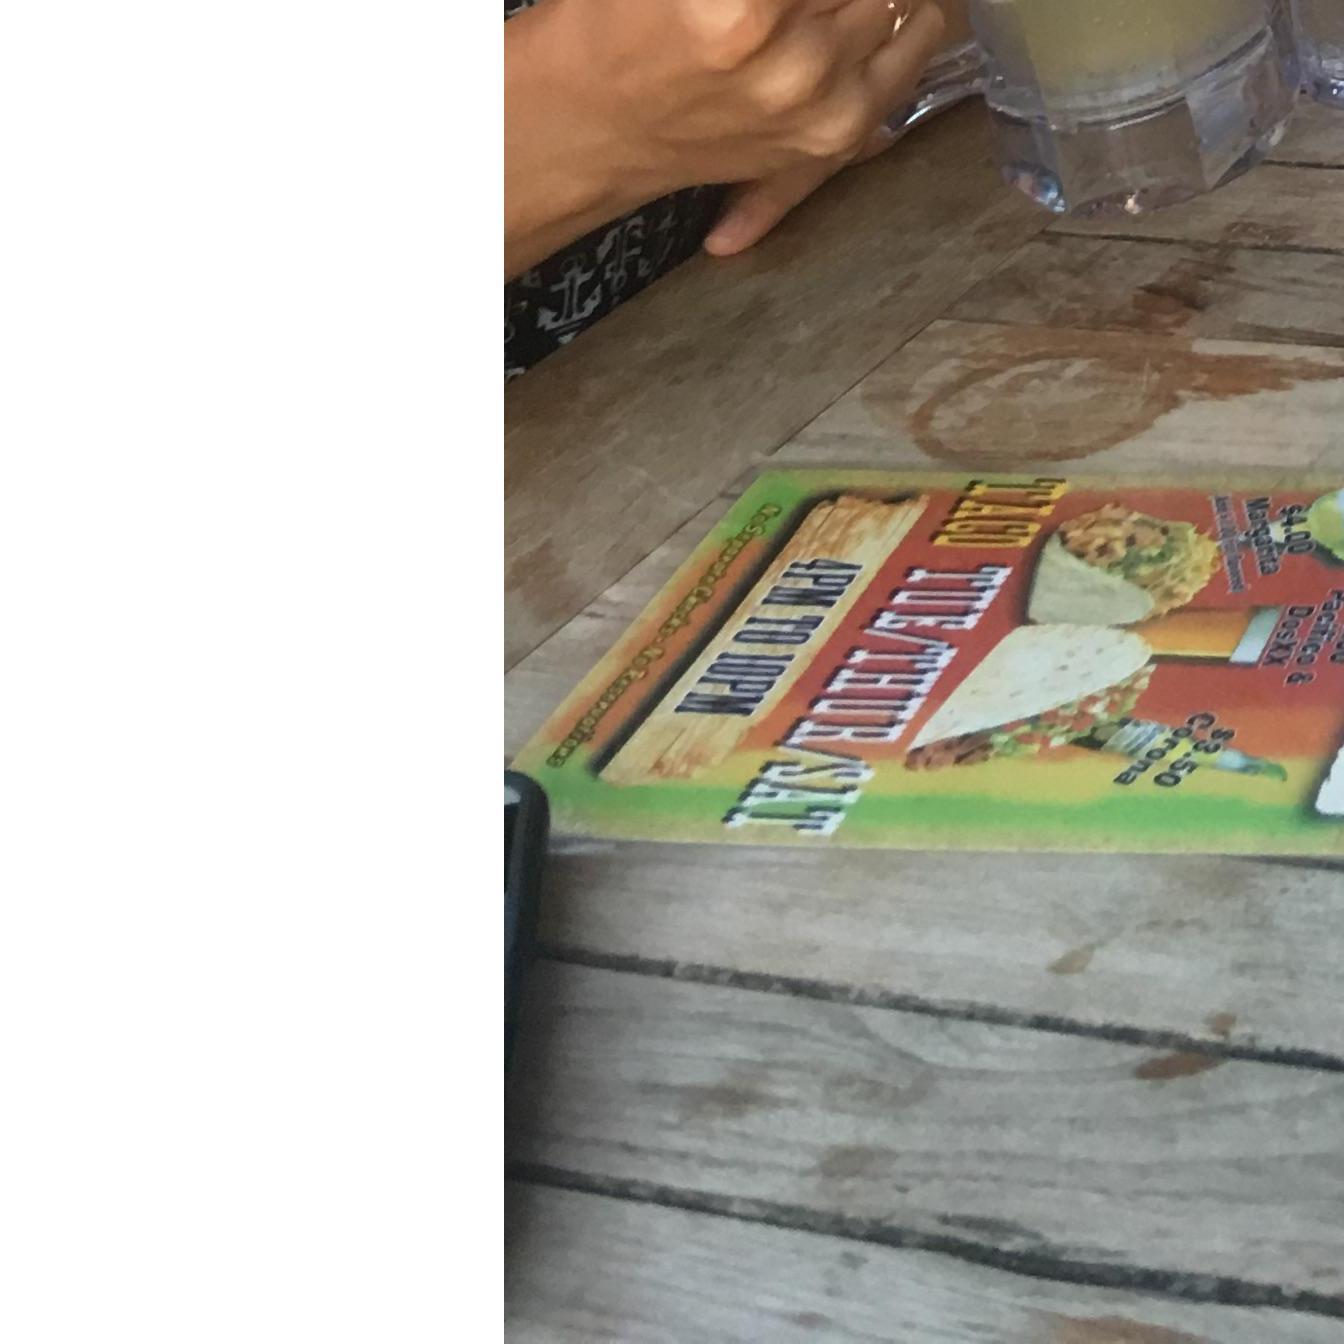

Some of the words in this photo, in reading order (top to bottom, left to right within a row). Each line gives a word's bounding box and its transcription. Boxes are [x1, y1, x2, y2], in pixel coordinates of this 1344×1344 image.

[1245, 496, 1282, 576] Margarita
[759, 557, 865, 609] 4PM
[730, 614, 827, 646] TO
[673, 653, 796, 717] 10PM
[1113, 712, 1217, 788] Corona
